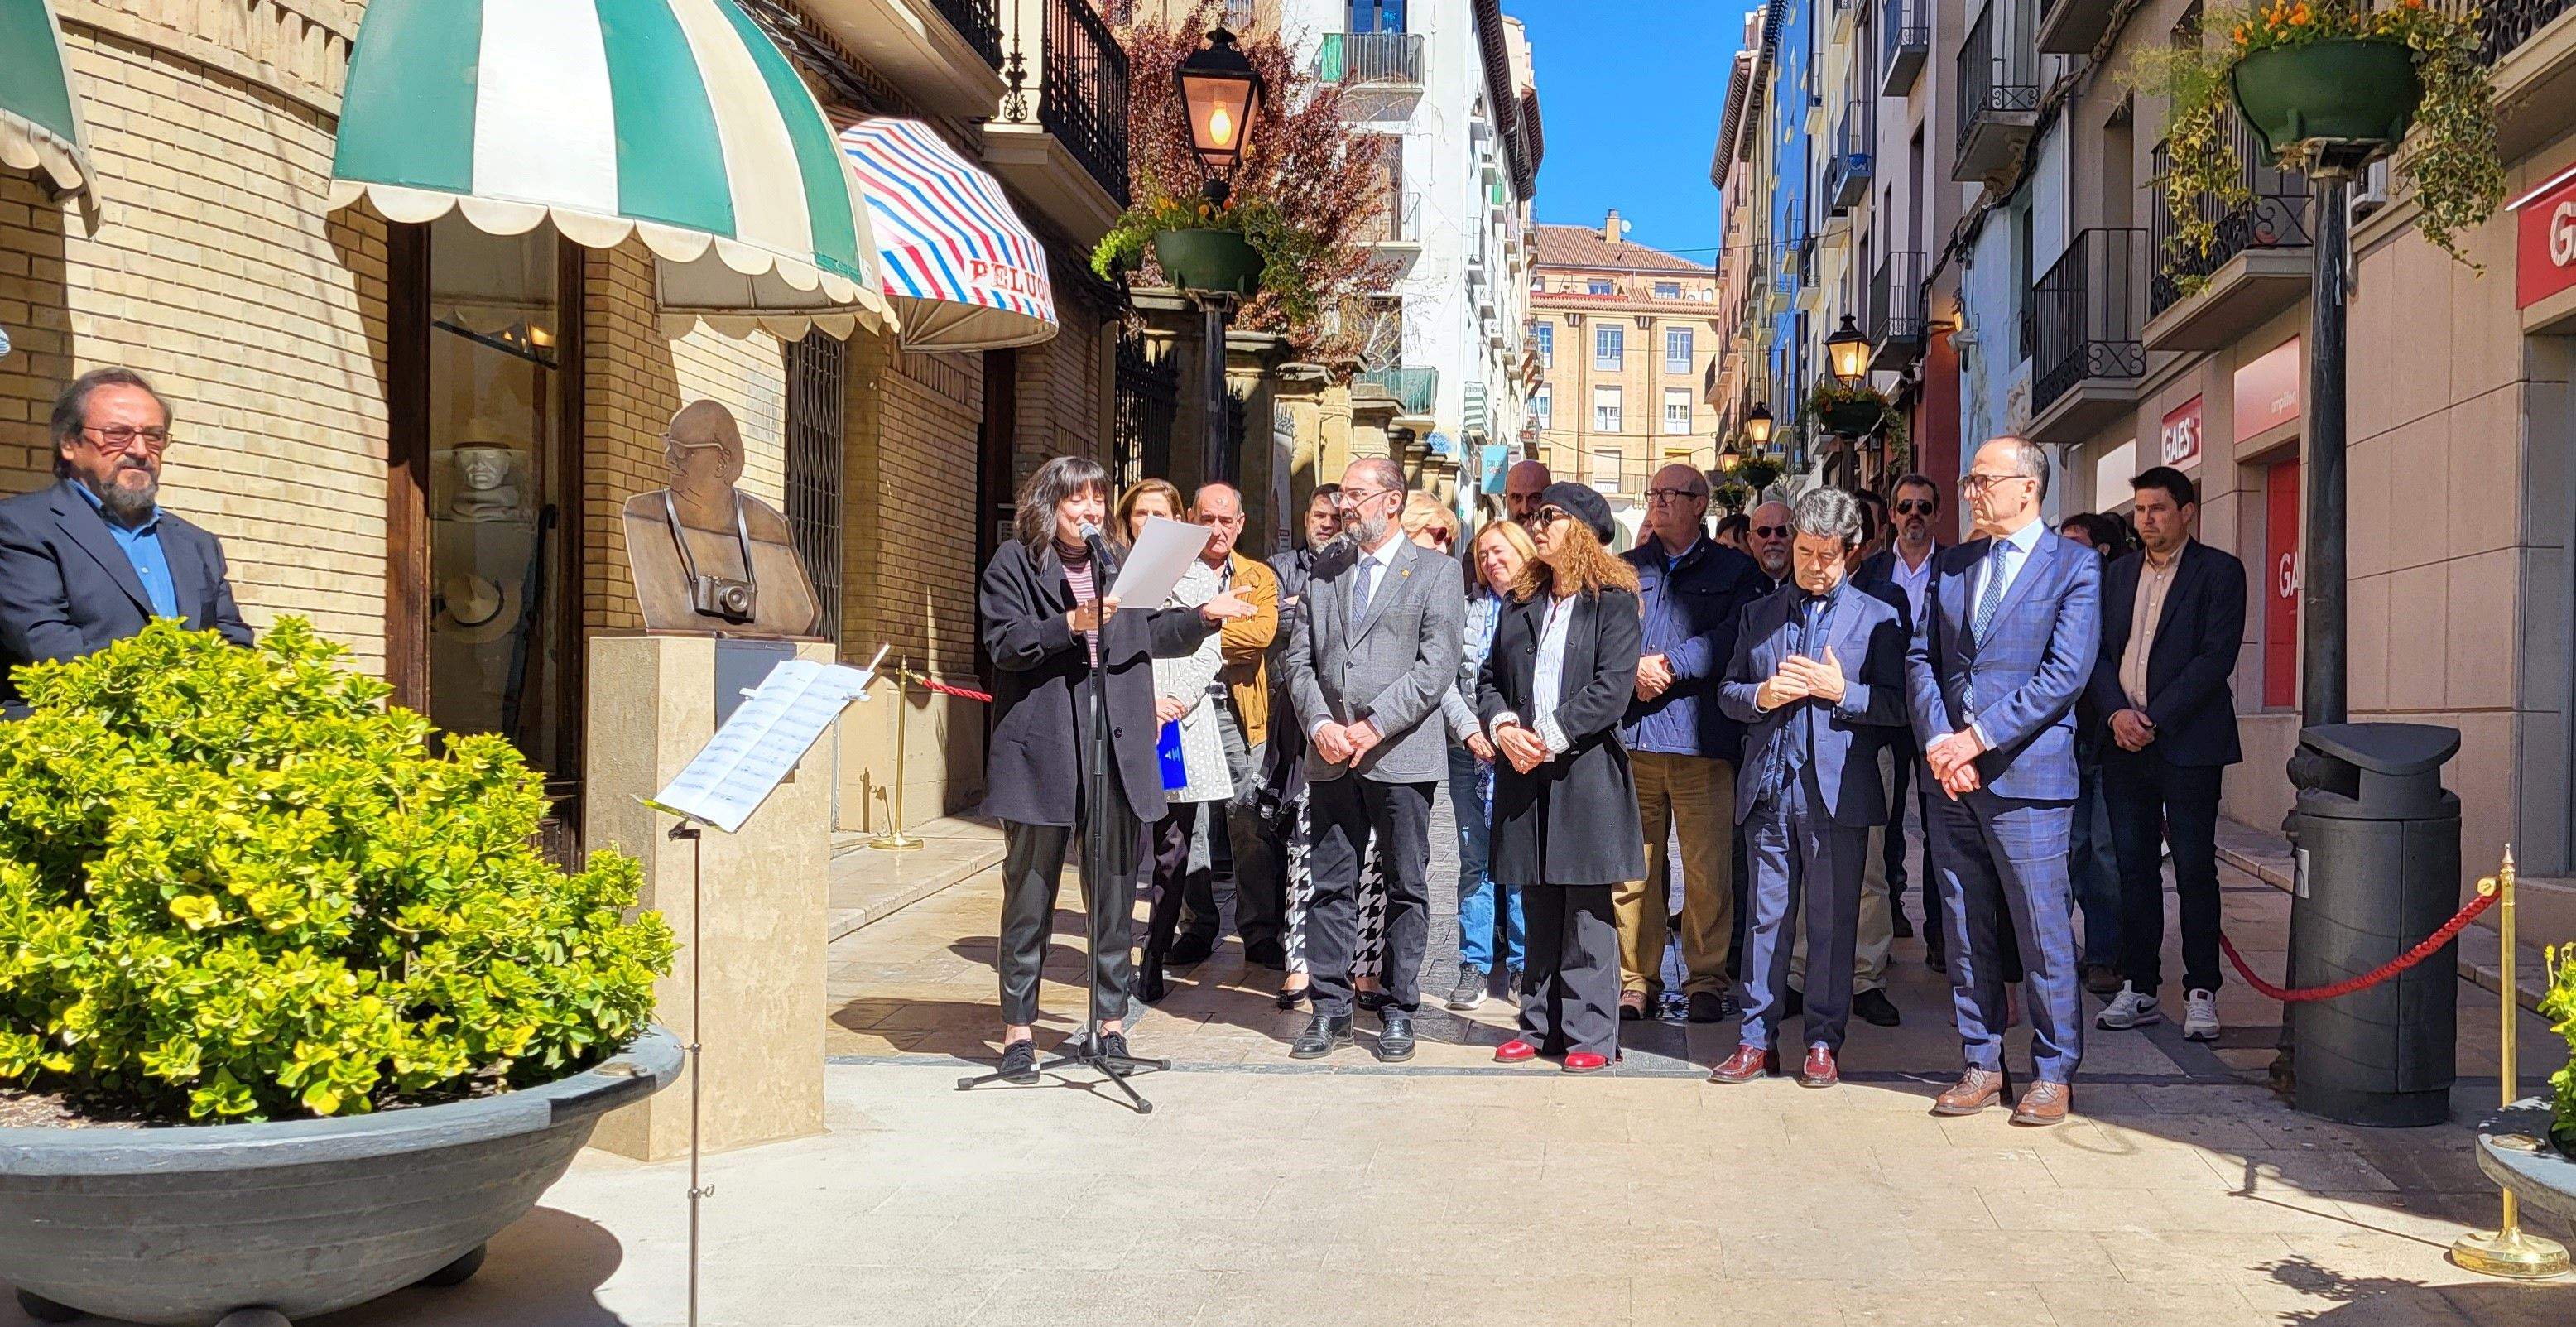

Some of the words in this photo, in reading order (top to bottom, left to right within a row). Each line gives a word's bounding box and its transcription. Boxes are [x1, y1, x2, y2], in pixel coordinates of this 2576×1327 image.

[2550, 201, 2576, 267] G
[970, 259, 1051, 305] PELUQ
[2164, 417, 2189, 464] GAES
